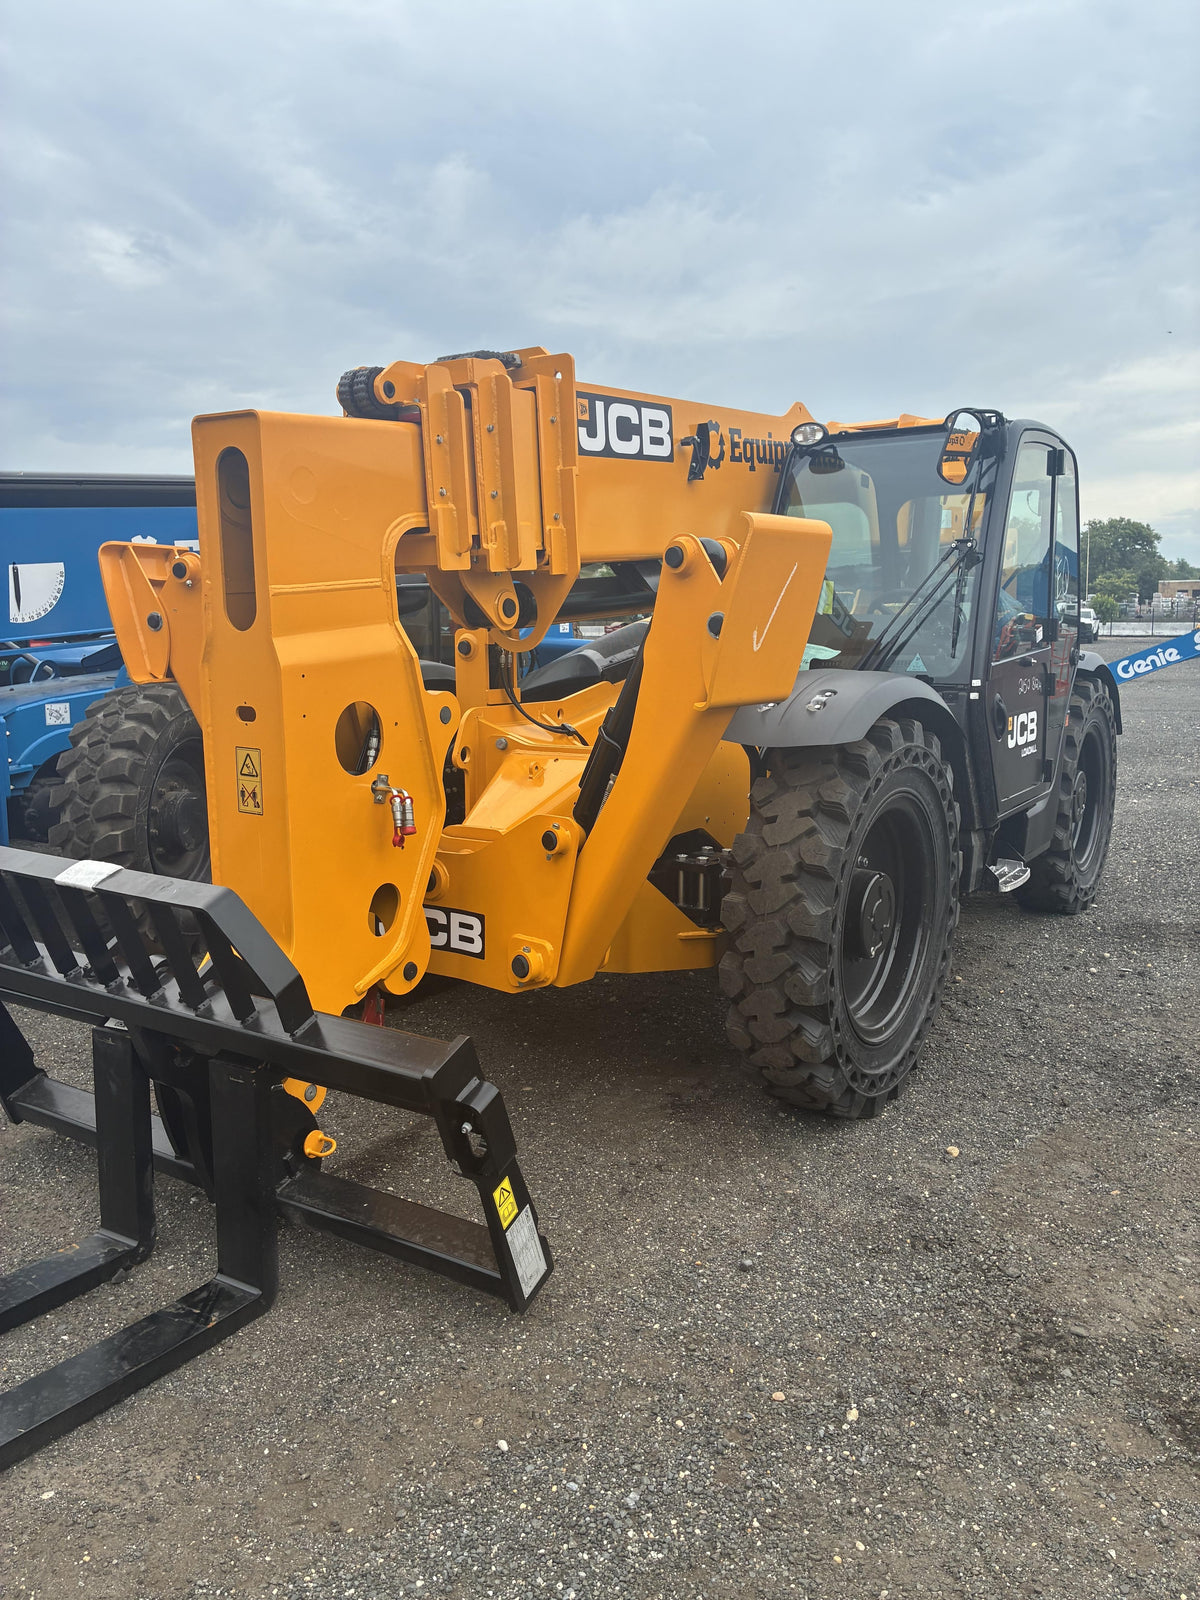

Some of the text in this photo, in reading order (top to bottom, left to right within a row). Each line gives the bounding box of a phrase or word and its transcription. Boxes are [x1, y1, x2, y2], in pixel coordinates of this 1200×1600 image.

[578, 400, 672, 457] JCB
[1117, 648, 1181, 678] Genie
[1008, 711, 1037, 748] JCB
[423, 907, 483, 954] CB
